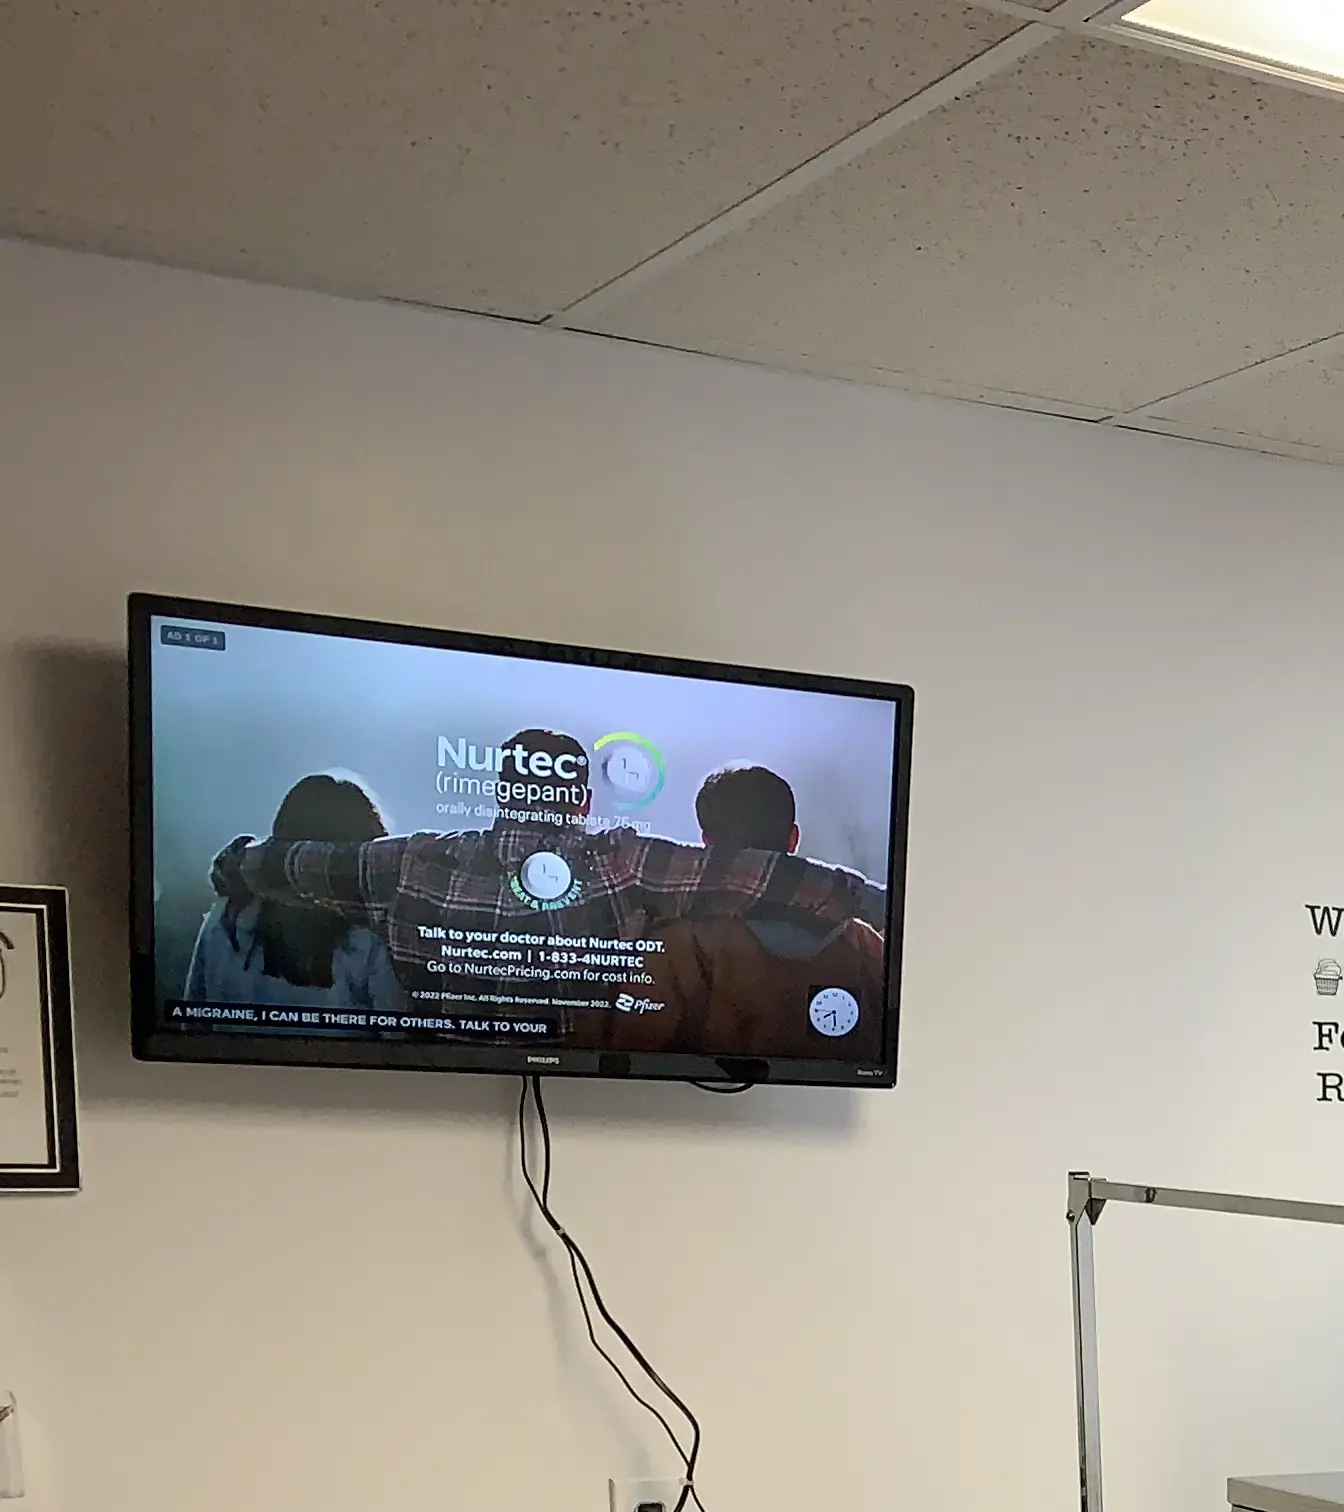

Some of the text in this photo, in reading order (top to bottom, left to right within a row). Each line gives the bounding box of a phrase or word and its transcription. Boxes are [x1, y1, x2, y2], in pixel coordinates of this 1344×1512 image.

[436, 771, 589, 806] (rimegepant)
[436, 802, 470, 818] orally
[474, 804, 564, 827] disintegrating
[417, 926, 666, 953] Talk to your doctor about Nurtec ODT.
[441, 945, 522, 961] Nurtec.com
[538, 950, 644, 968] 1-833-4NURTEC
[427, 960, 656, 985] Go to NurtecPricing.com for cost info.
[634, 998, 666, 1015] Pfizer
[172, 1006, 182, 1017] A
[186, 1007, 258, 1021] MIGRAINE,
[269, 1010, 299, 1022] CAN
[301, 1012, 320, 1023] BE
[322, 1013, 366, 1026] THERE
[369, 1016, 397, 1027] FOR
[400, 1017, 456, 1029] OTHERS.
[459, 1019, 490, 1031] TALK
[493, 1021, 511, 1032] TO
[512, 1022, 547, 1033] YOUR
